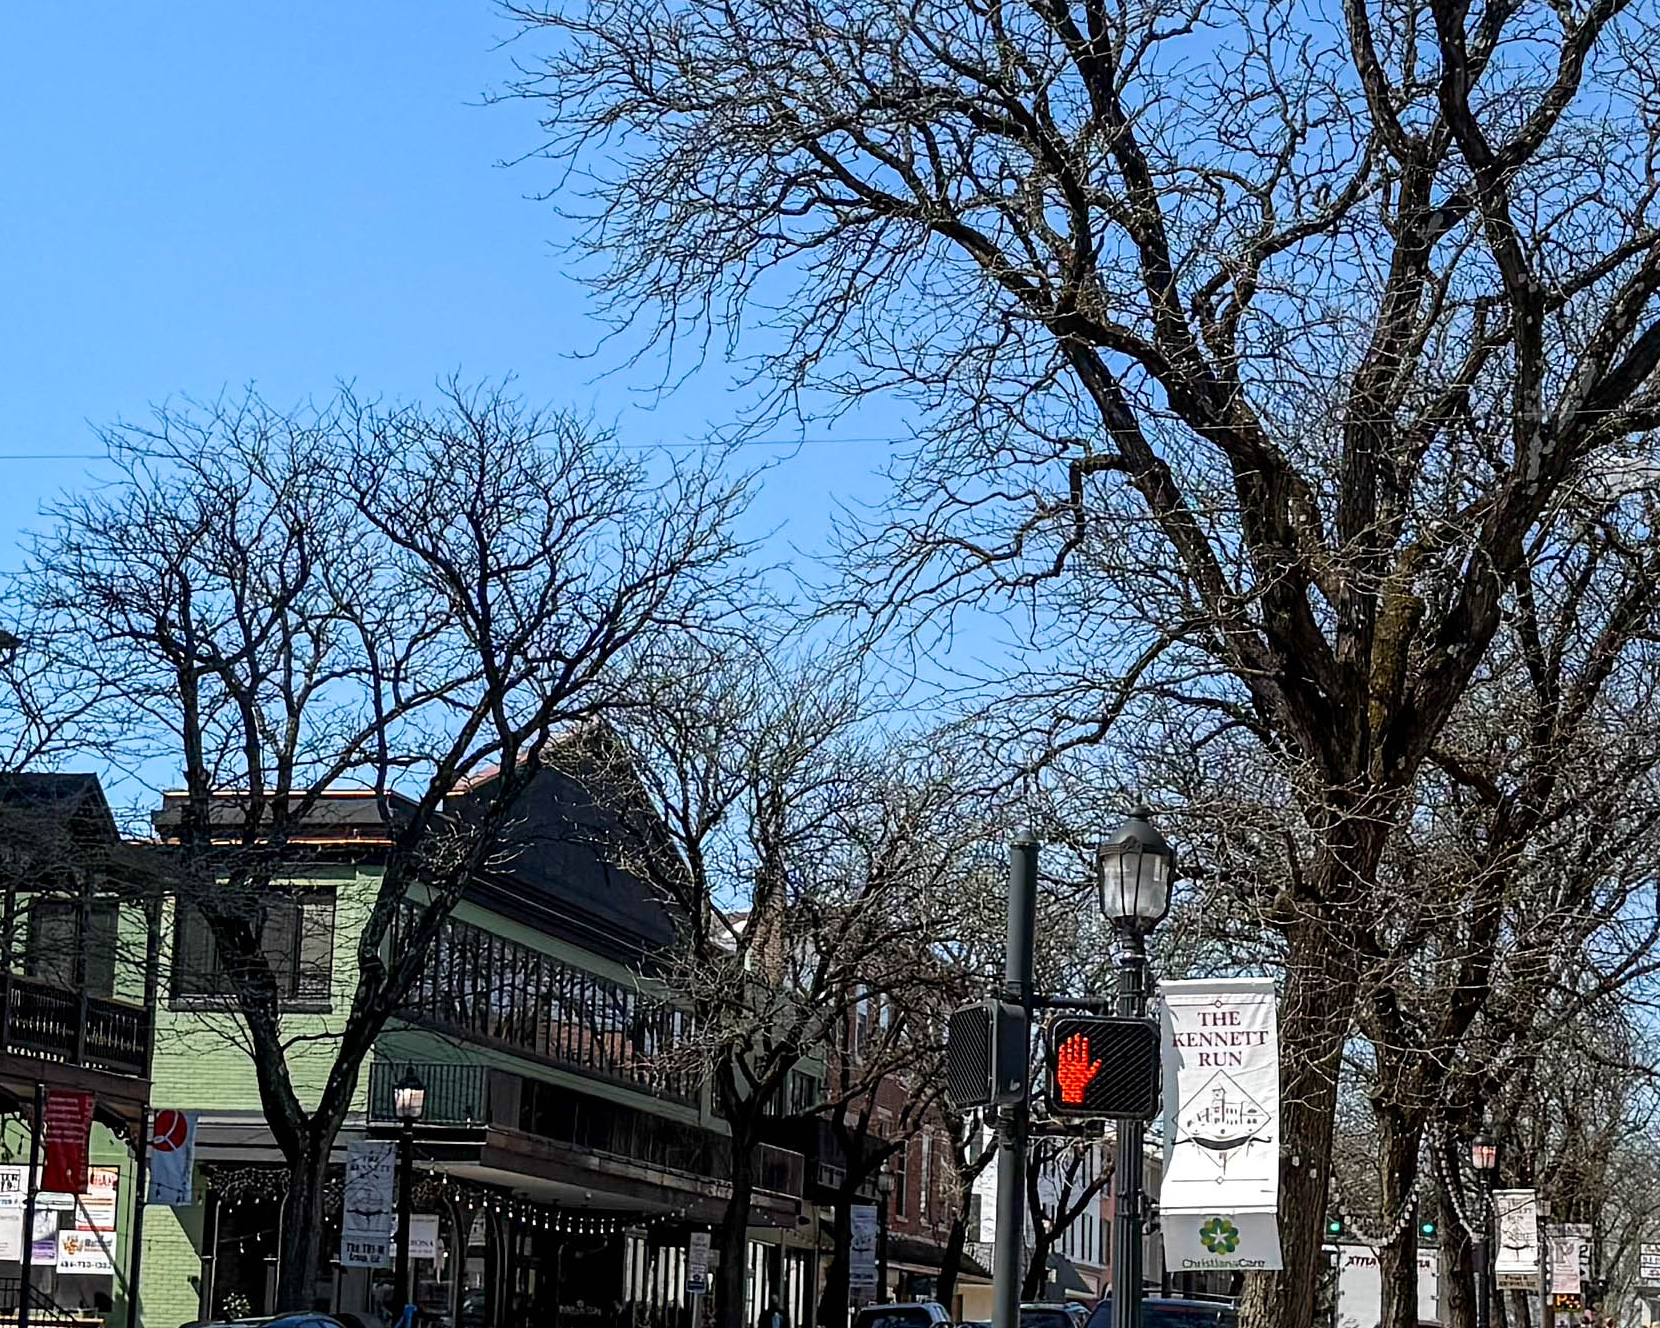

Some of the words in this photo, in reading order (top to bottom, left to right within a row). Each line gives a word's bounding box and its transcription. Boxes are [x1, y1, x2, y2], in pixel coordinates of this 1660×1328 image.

[1198, 1011, 1241, 1027] THE
[1172, 1030, 1269, 1048] KENNETT
[1199, 1052, 1242, 1067] RUN
